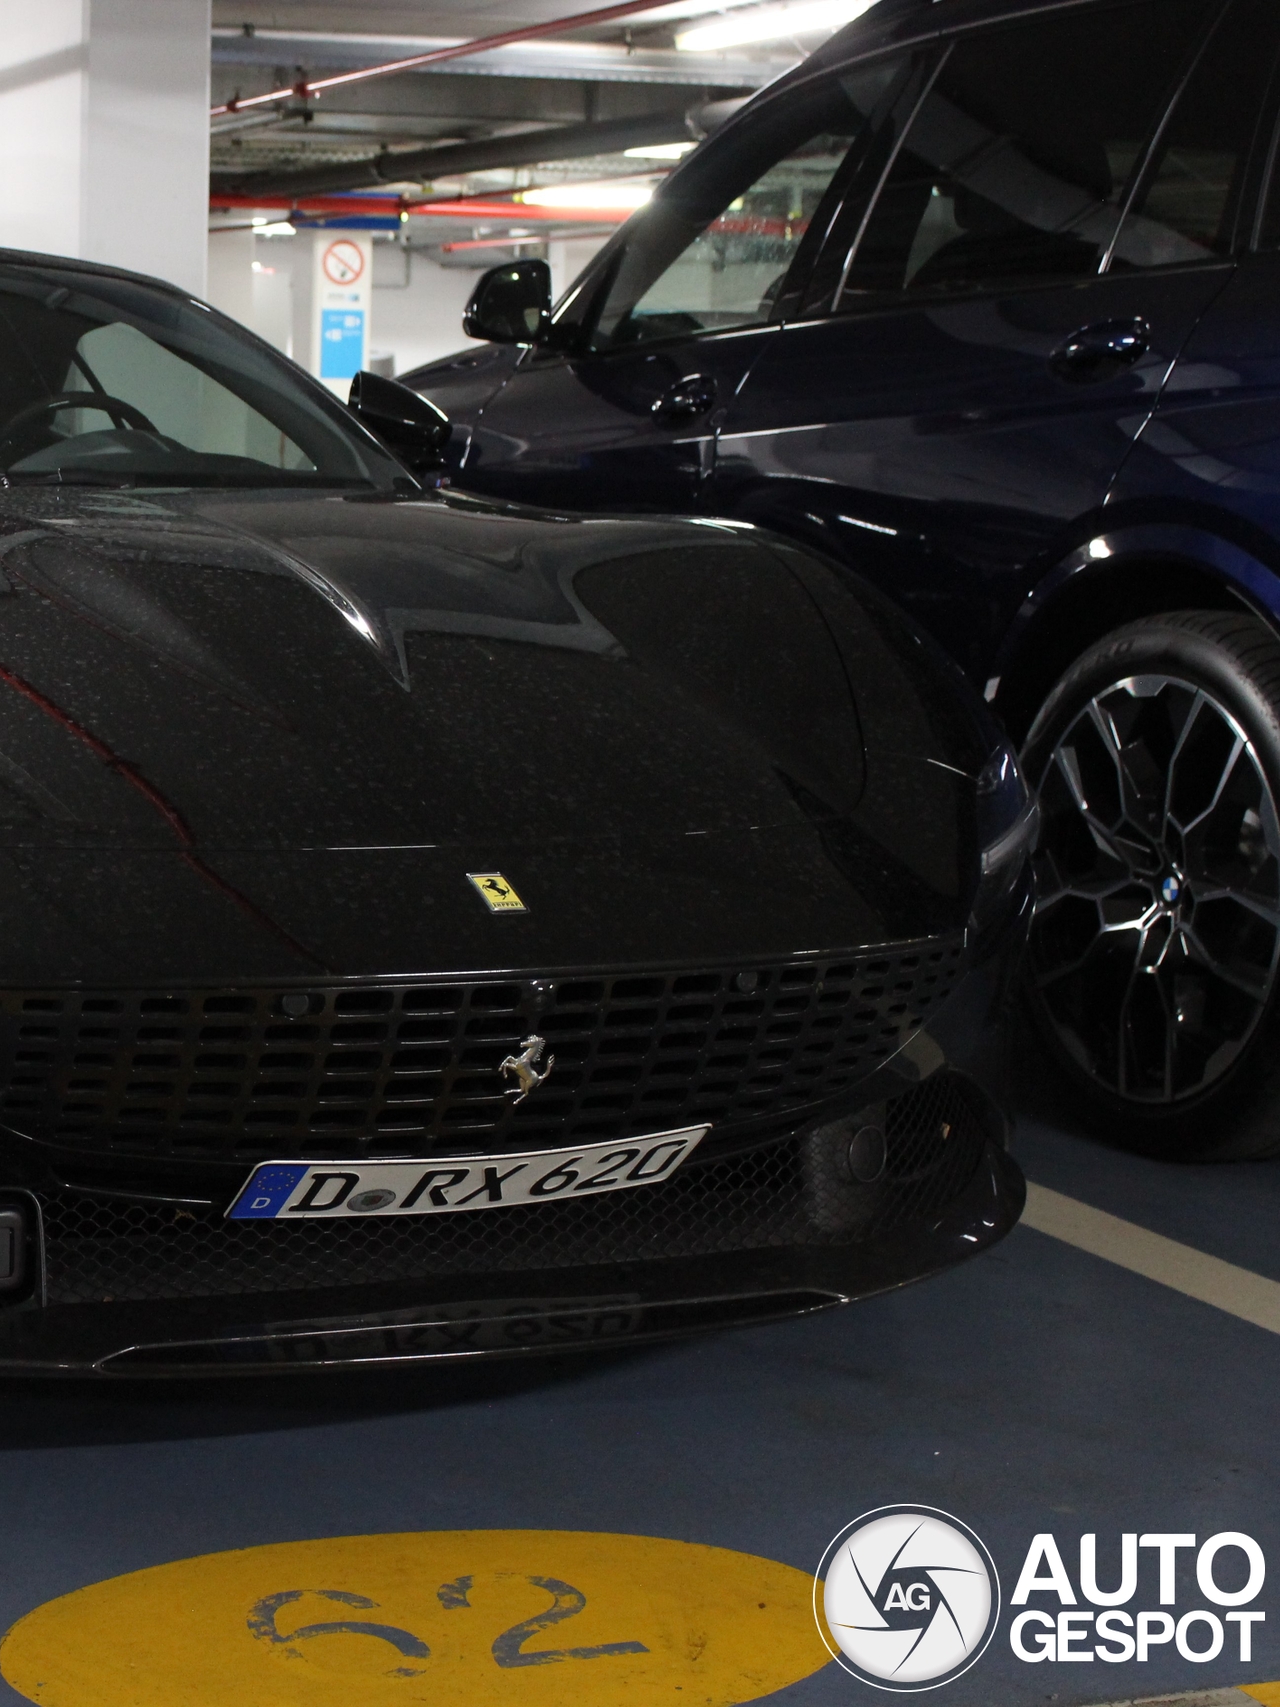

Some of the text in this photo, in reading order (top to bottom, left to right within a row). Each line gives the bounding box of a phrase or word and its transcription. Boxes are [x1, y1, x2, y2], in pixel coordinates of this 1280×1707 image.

[288, 1138, 691, 1213] D RX 620
[250, 1197, 271, 1209] D
